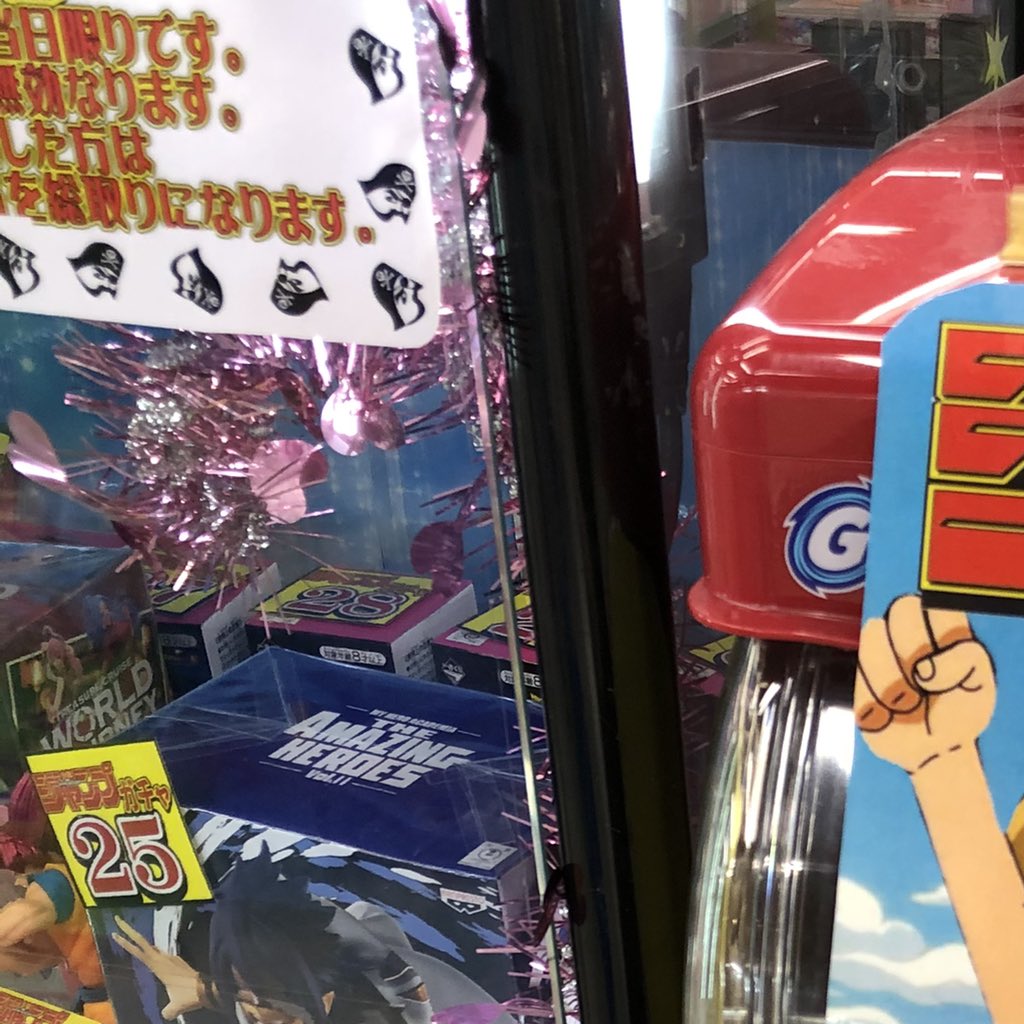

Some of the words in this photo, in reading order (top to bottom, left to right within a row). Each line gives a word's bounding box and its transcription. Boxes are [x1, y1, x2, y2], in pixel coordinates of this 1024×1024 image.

[280, 584, 409, 622] 28
[40, 659, 154, 750] WORLD
[371, 719, 438, 740] THE
[268, 738, 433, 789] HEROES
[283, 710, 476, 770] AMAZING
[68, 810, 188, 903] 25
